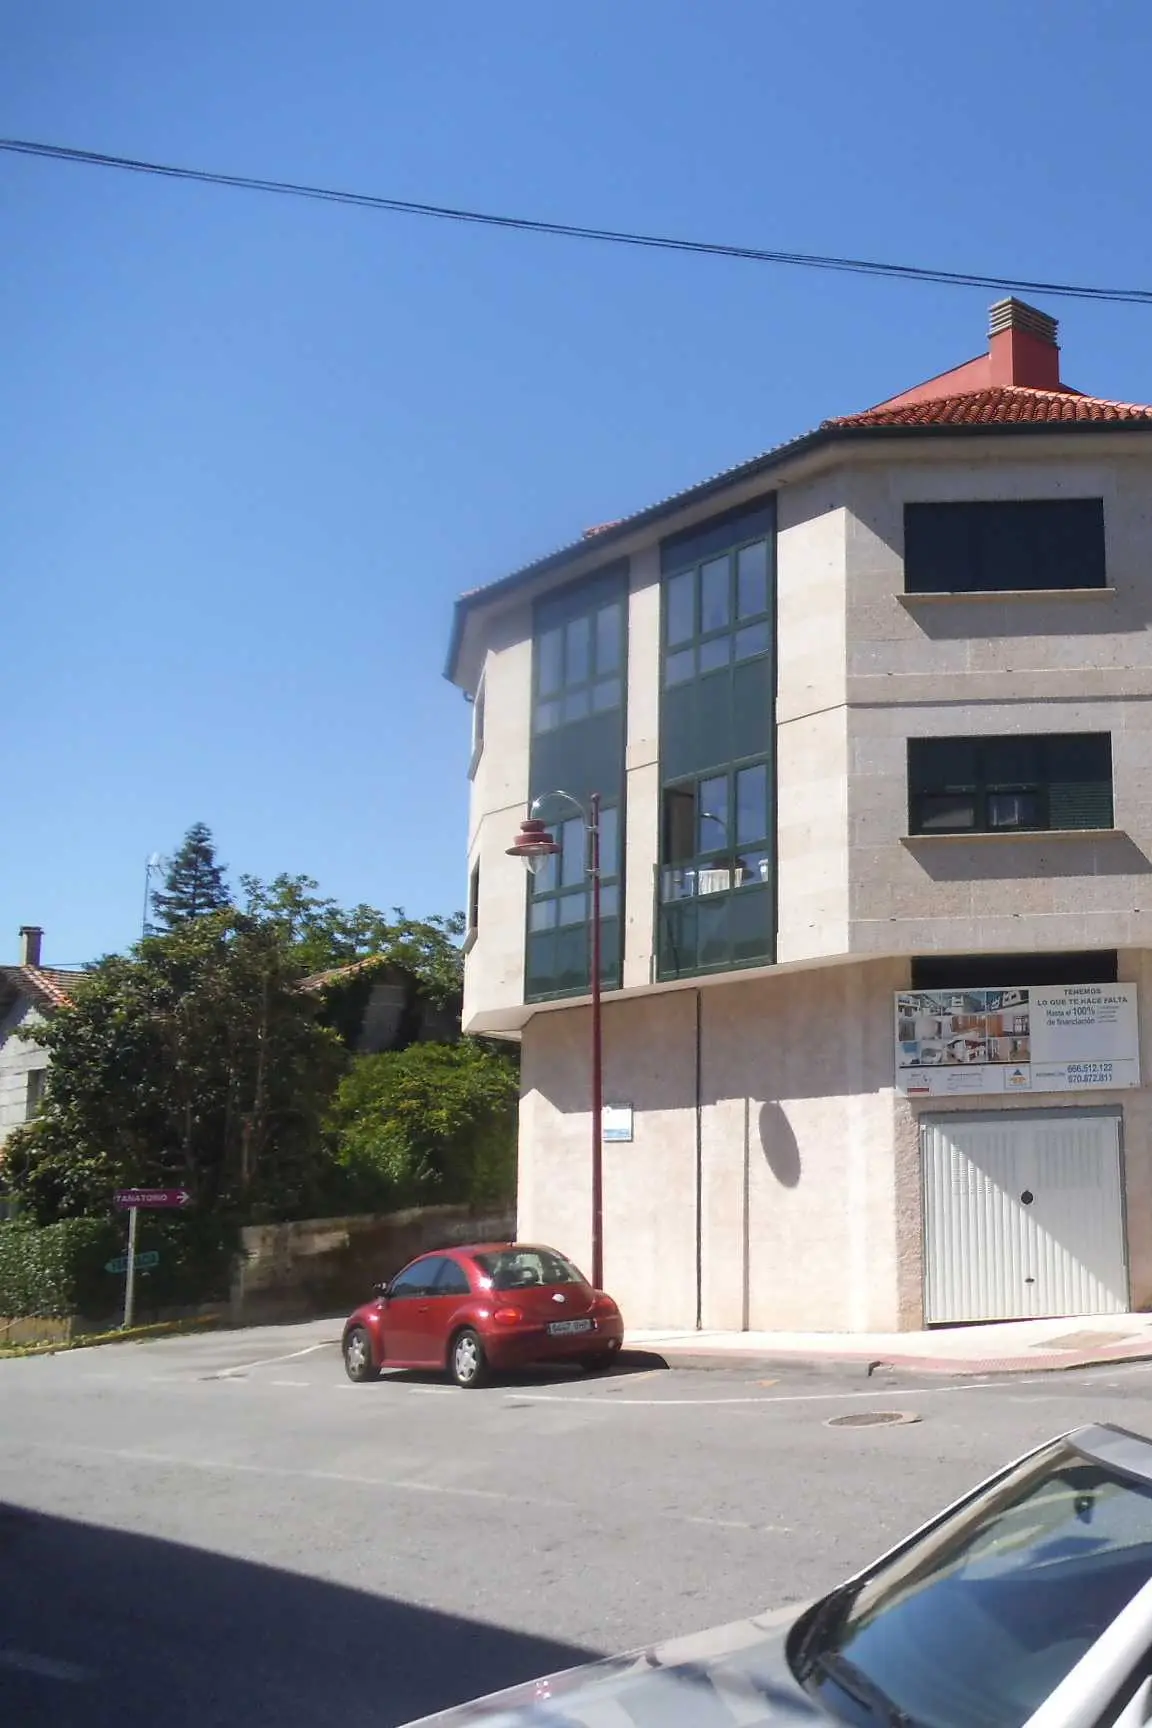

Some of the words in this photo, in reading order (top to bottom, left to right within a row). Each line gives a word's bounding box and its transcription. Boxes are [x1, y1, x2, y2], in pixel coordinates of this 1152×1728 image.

[1064, 988, 1102, 996] TENEMOS
[1080, 997, 1102, 1005] HACE
[1073, 1006, 1096, 1016] 100%
[1046, 1018, 1055, 1026] de
[116, 1194, 168, 1203] TANATORIO
